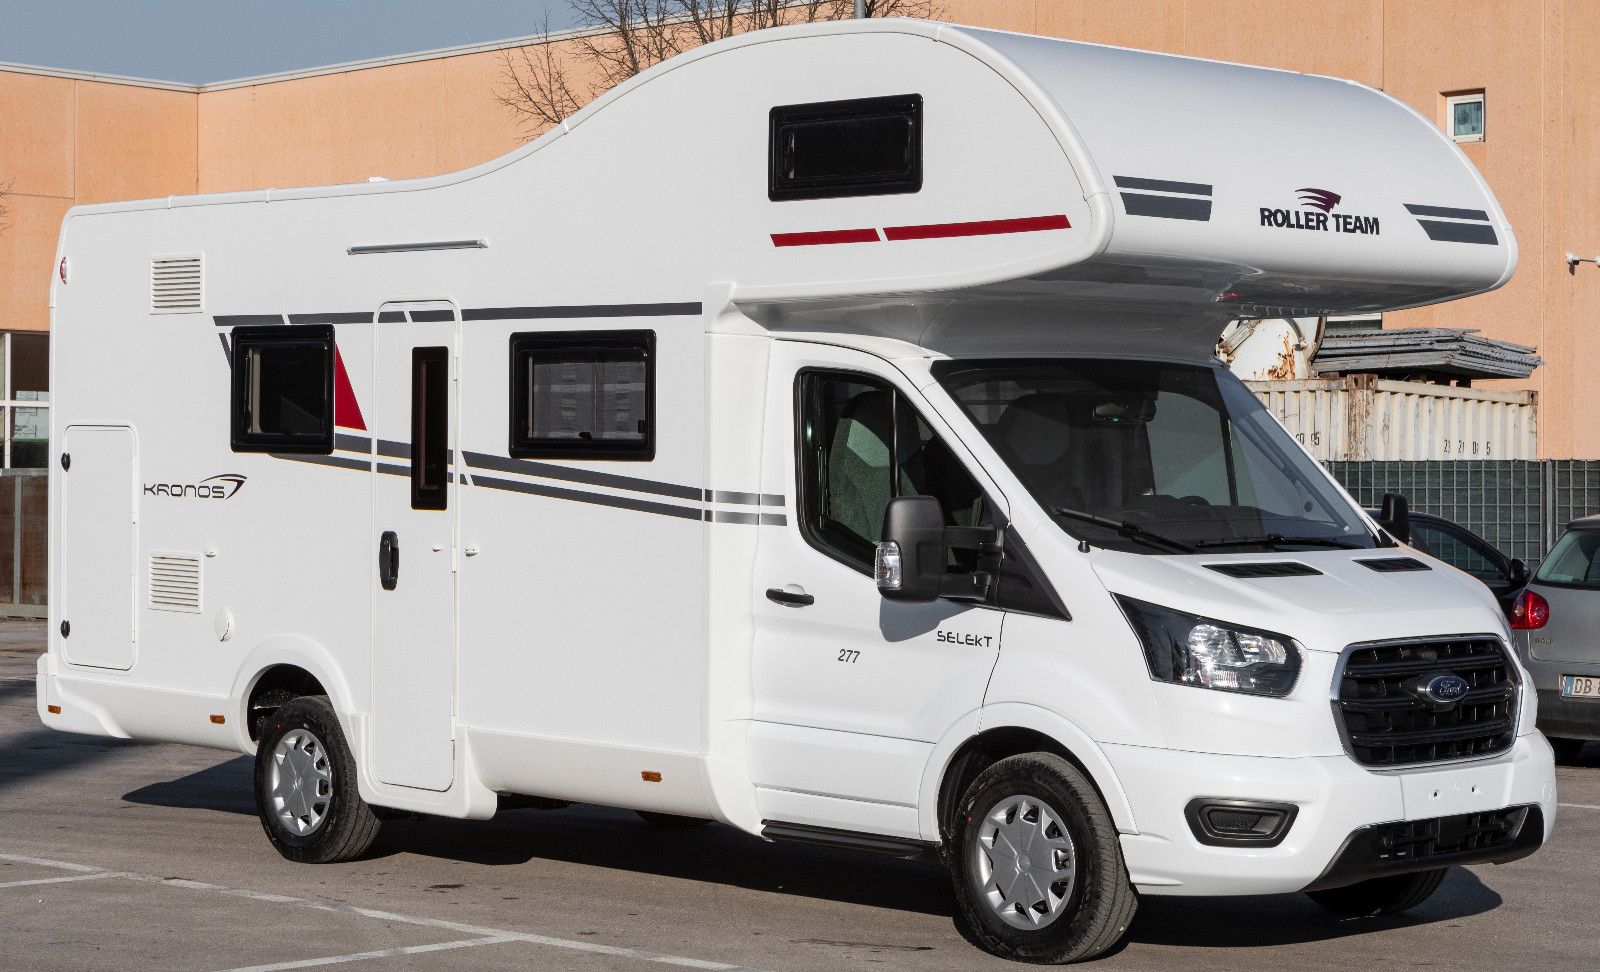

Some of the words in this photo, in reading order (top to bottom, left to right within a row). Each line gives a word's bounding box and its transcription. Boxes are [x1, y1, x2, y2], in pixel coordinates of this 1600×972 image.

[1259, 207, 1329, 232] ROLLER
[1331, 213, 1380, 236] TEAM
[143, 483, 225, 499] KRONOS
[936, 630, 993, 648] SELEKT
[837, 648, 861, 664] 277
[1440, 680, 1462, 696] Ford
